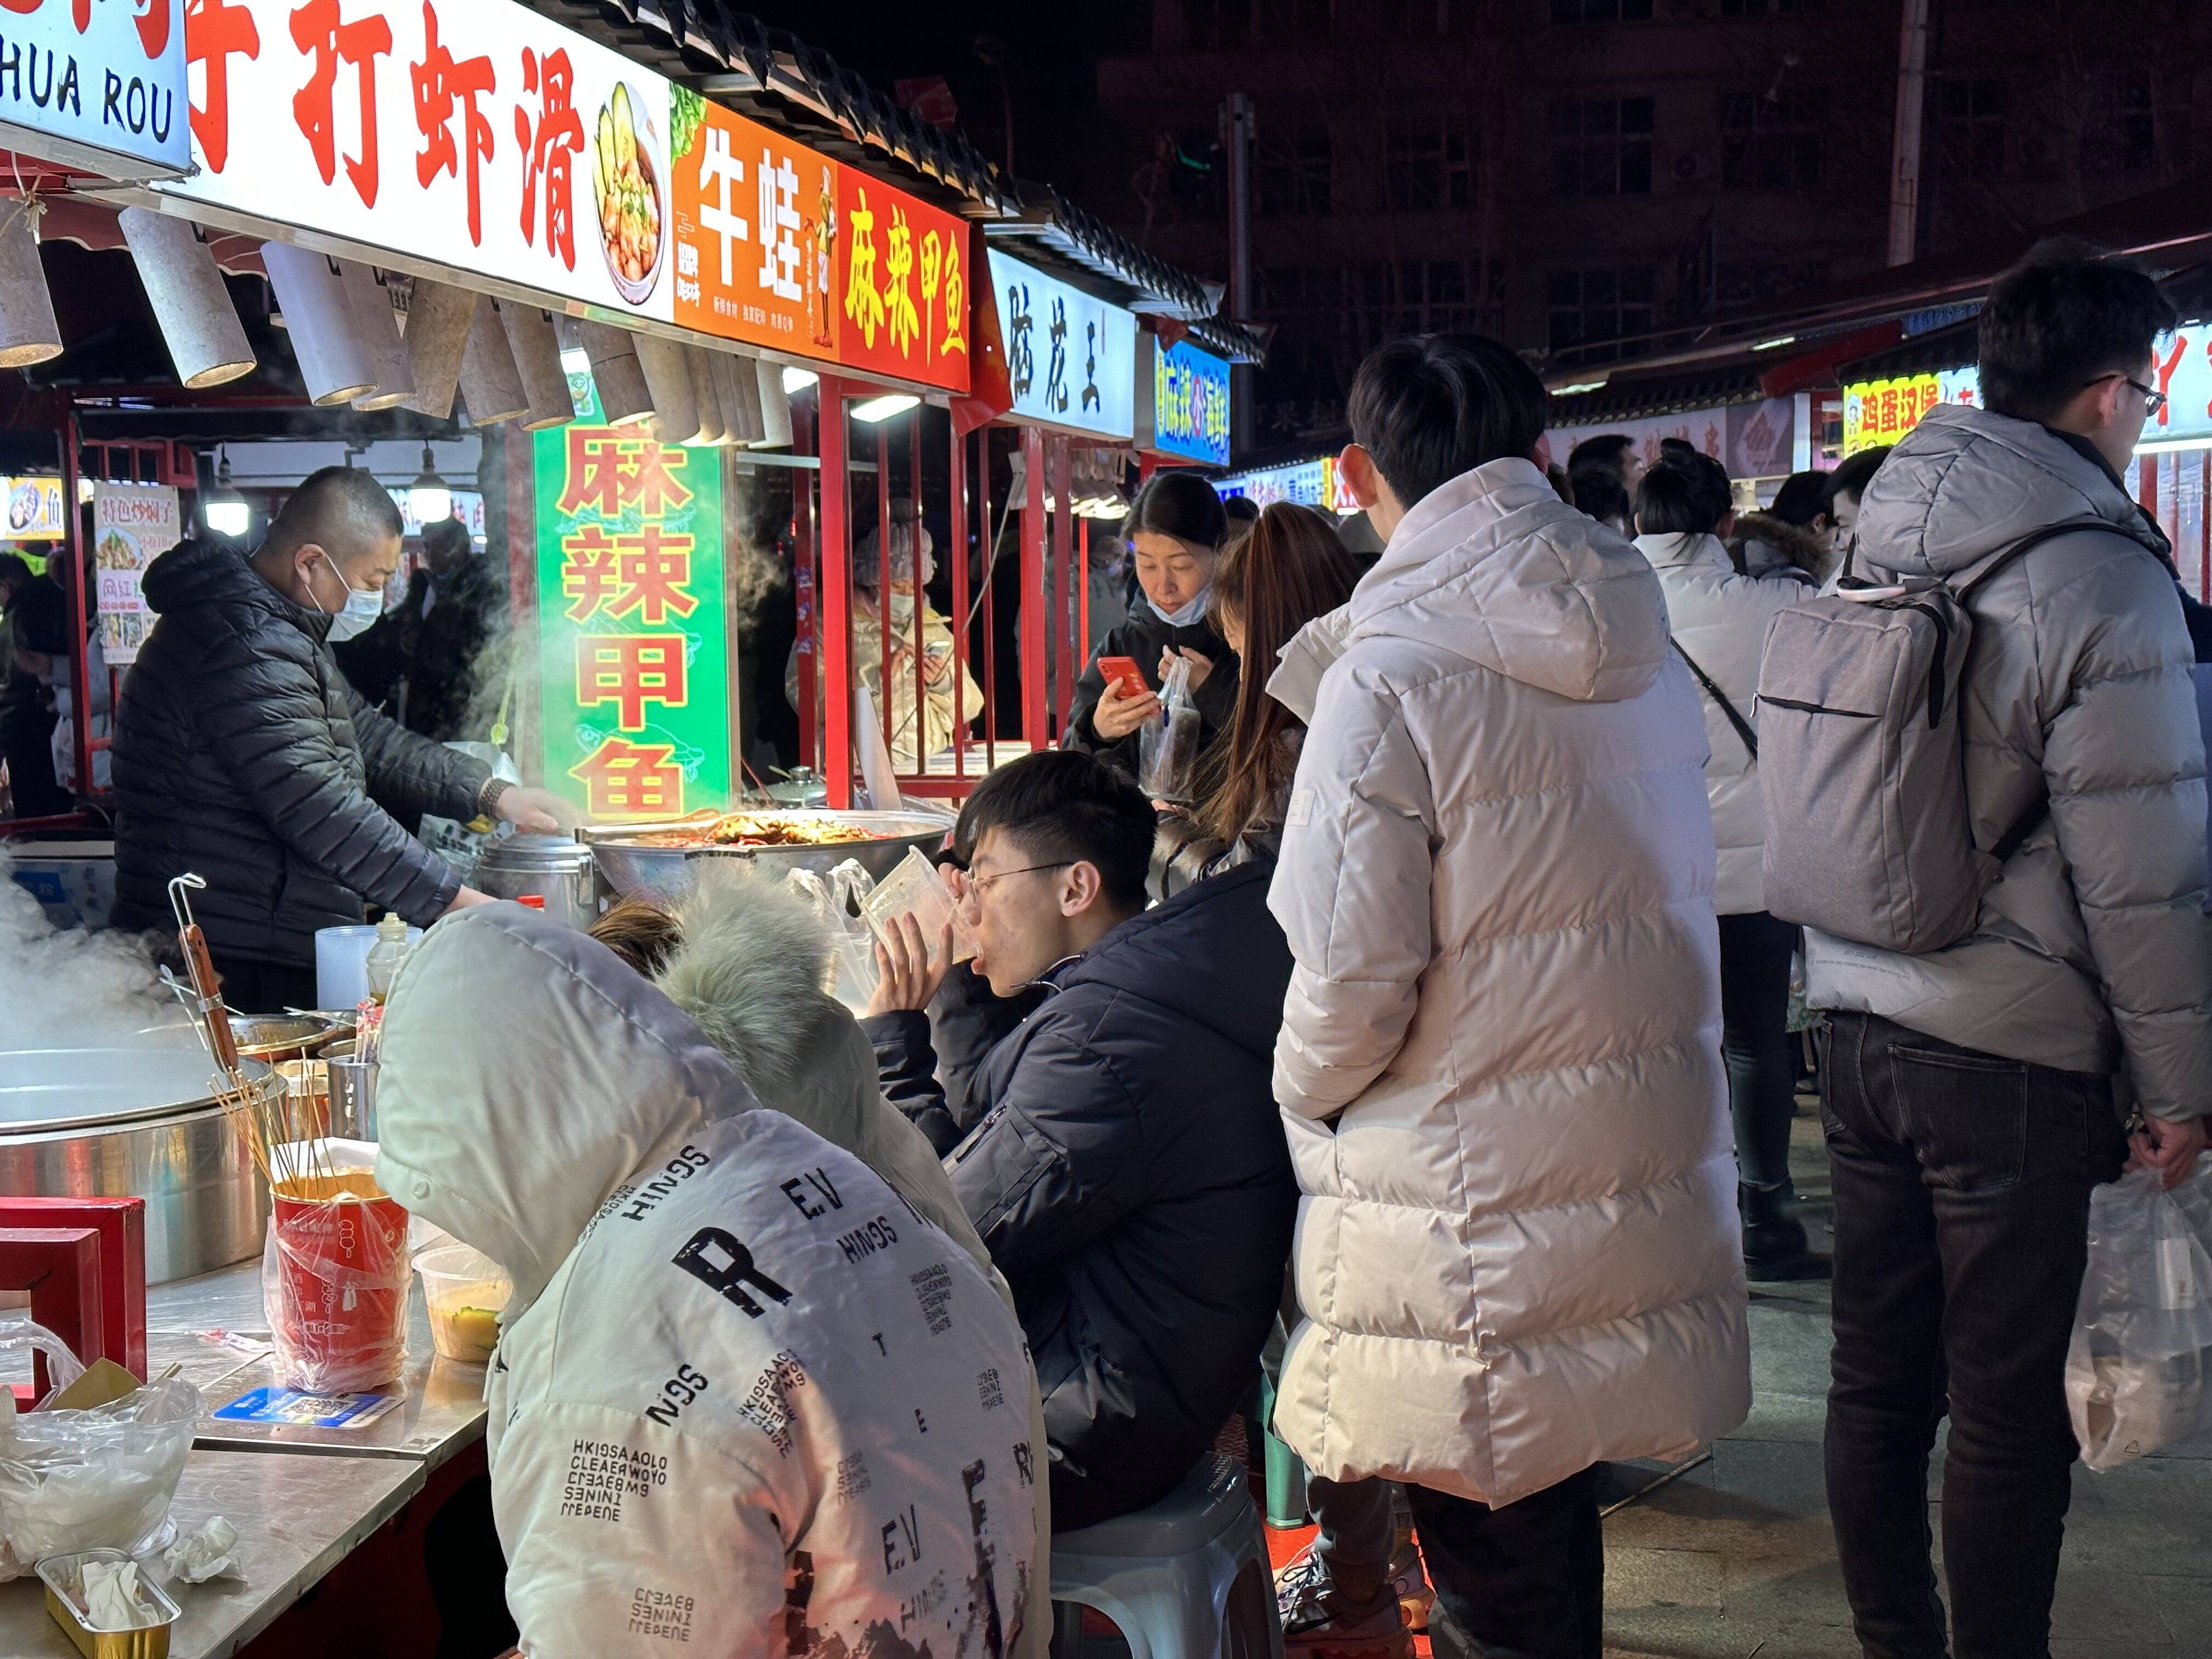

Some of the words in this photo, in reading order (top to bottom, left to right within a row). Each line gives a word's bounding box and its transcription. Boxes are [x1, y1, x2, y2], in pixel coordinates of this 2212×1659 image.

[104, 67, 172, 144] ROU
[188, 0, 584, 273] 手打虾滑
[699, 126, 803, 303] 牛蛙
[845, 188, 966, 366] 麻辣甲鱼
[1862, 383, 1938, 434] 鸡蛋汉堡
[555, 424, 698, 819] 麻辣甲鱼
[671, 1227, 793, 1319] R
